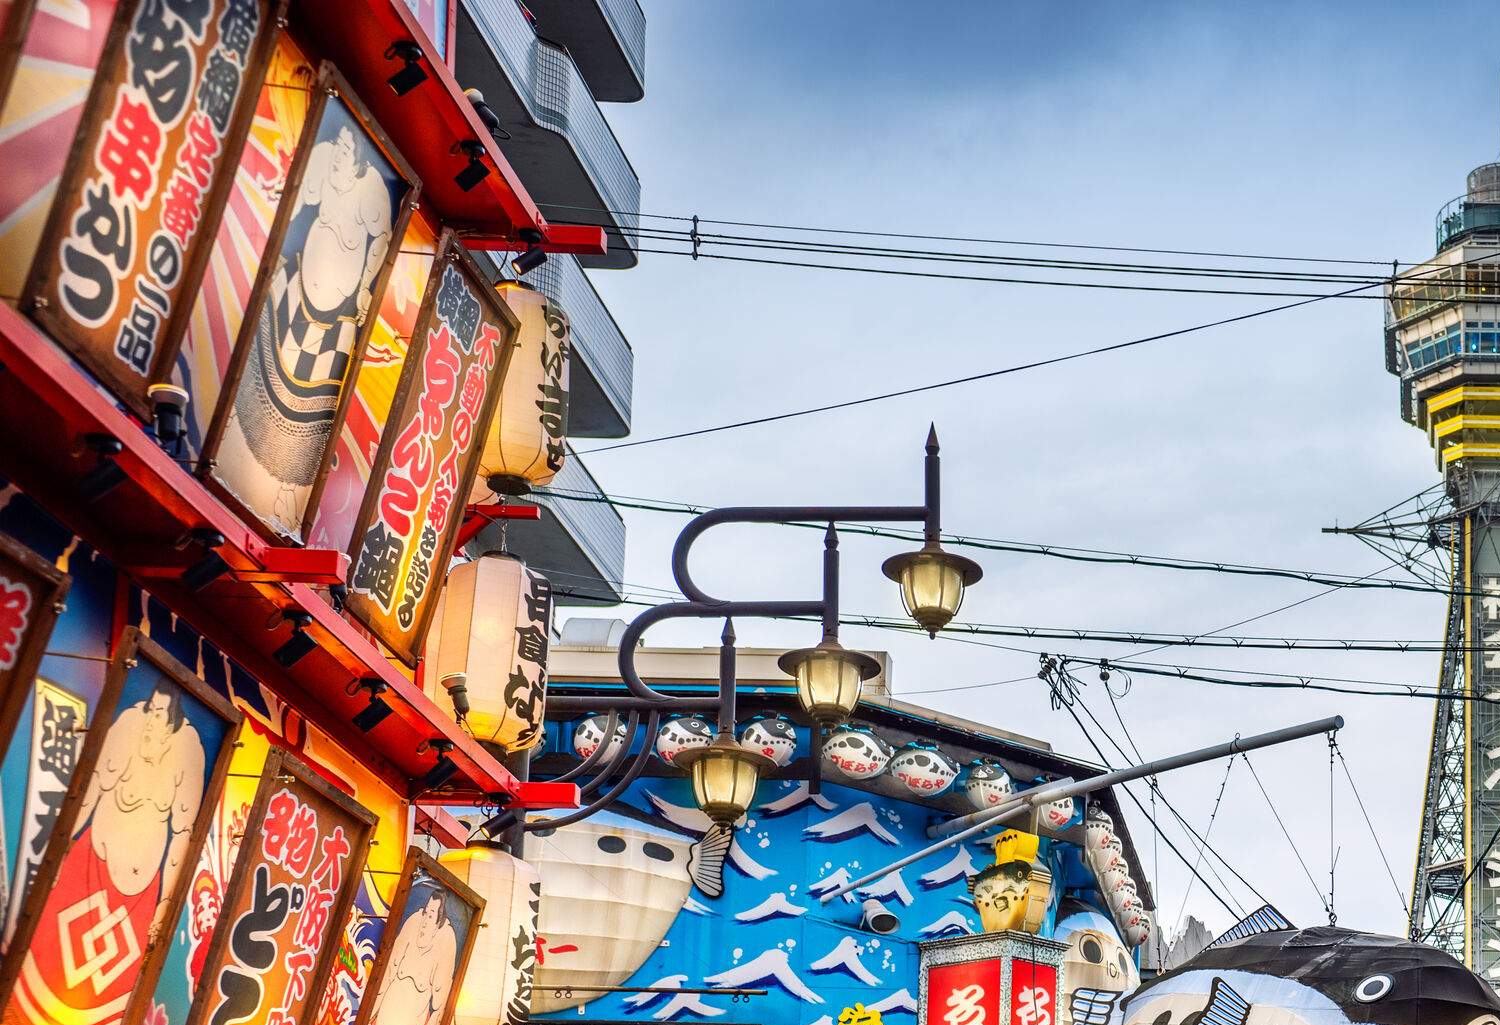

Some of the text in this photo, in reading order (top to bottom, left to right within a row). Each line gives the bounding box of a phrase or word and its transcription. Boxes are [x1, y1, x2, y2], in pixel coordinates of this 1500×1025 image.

[61, 0, 212, 328] 物串かつ
[353, 323, 459, 613] ちゃんこ鍋
[263, 790, 317, 878] 名物
